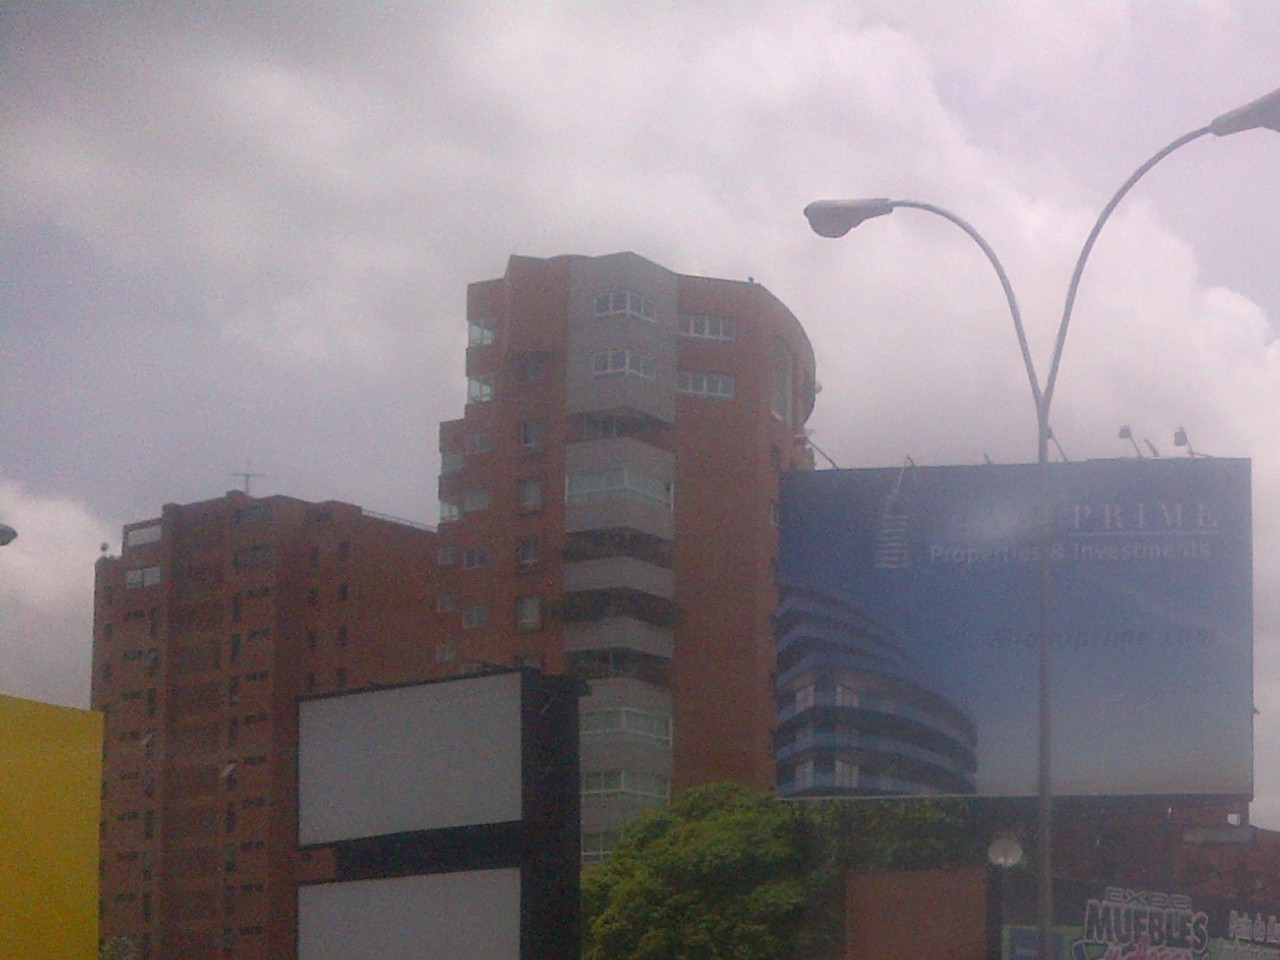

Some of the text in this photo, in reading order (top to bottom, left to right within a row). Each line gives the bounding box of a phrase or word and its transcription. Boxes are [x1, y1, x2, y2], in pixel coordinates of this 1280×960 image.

[1072, 503, 1219, 530] PRIME
[929, 540, 1212, 565] Properties & Investments
[1105, 887, 1192, 910] EXPO
[1084, 899, 1208, 953] MUEBLES
